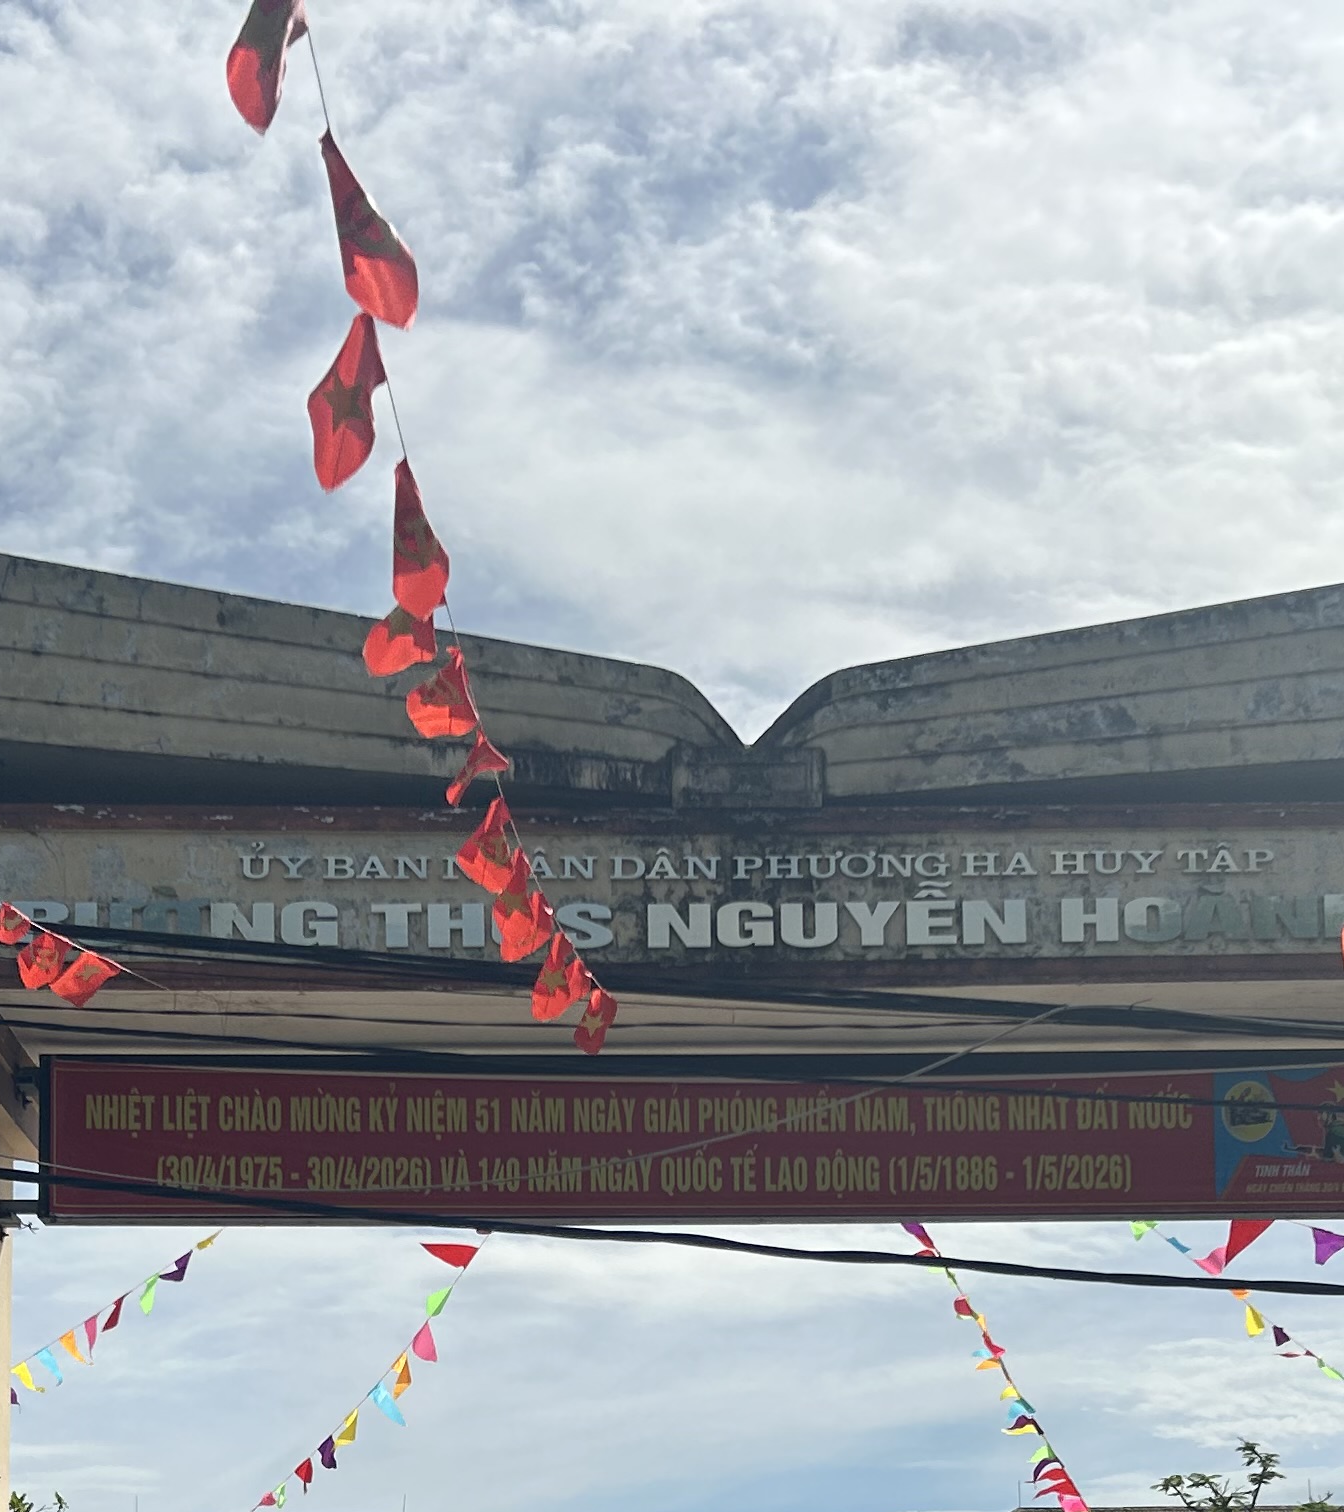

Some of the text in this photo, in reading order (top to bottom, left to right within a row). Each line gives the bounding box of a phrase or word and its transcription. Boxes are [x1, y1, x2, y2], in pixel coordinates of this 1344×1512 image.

[240, 841, 311, 880] ỦY
[322, 855, 430, 880] BAN
[442, 847, 597, 880] ÂN
[609, 847, 721, 880] DÂN
[961, 851, 1038, 877] HA
[1050, 850, 1163, 876] HUY
[371, 902, 614, 949] THS
[647, 880, 1027, 949] NGUYỄN
[85, 1087, 156, 1139] NHIỆT
[162, 1088, 212, 1139] LIỆT
[218, 1088, 282, 1133] CHÀO
[290, 1088, 361, 1133] MỪNG
[368, 1082, 400, 1133] KỶ
[406, 1089, 468, 1140] NIỆM
[475, 1098, 501, 1133] 51
[511, 1089, 566, 1133] NĂM
[573, 1090, 636, 1133] NGÀY
[698, 1090, 778, 1134] PHÓNG
[786, 1084, 846, 1133] MIỀN
[857, 1096, 916, 1136] NAM,
[927, 1085, 1001, 1132] THỐNG
[1008, 1082, 1069, 1131] NHẤT
[1076, 1081, 1120, 1130] ĐẤT
[1128, 1082, 1193, 1130] NƯỚC
[157, 1143, 1132, 1199] (30/4/1975 - 30/4/2026) VÀ 140 NĂM NGÀY QUỐC TẾ LAO ĐỘNG (1/5/1886 - 1/5/2026)
